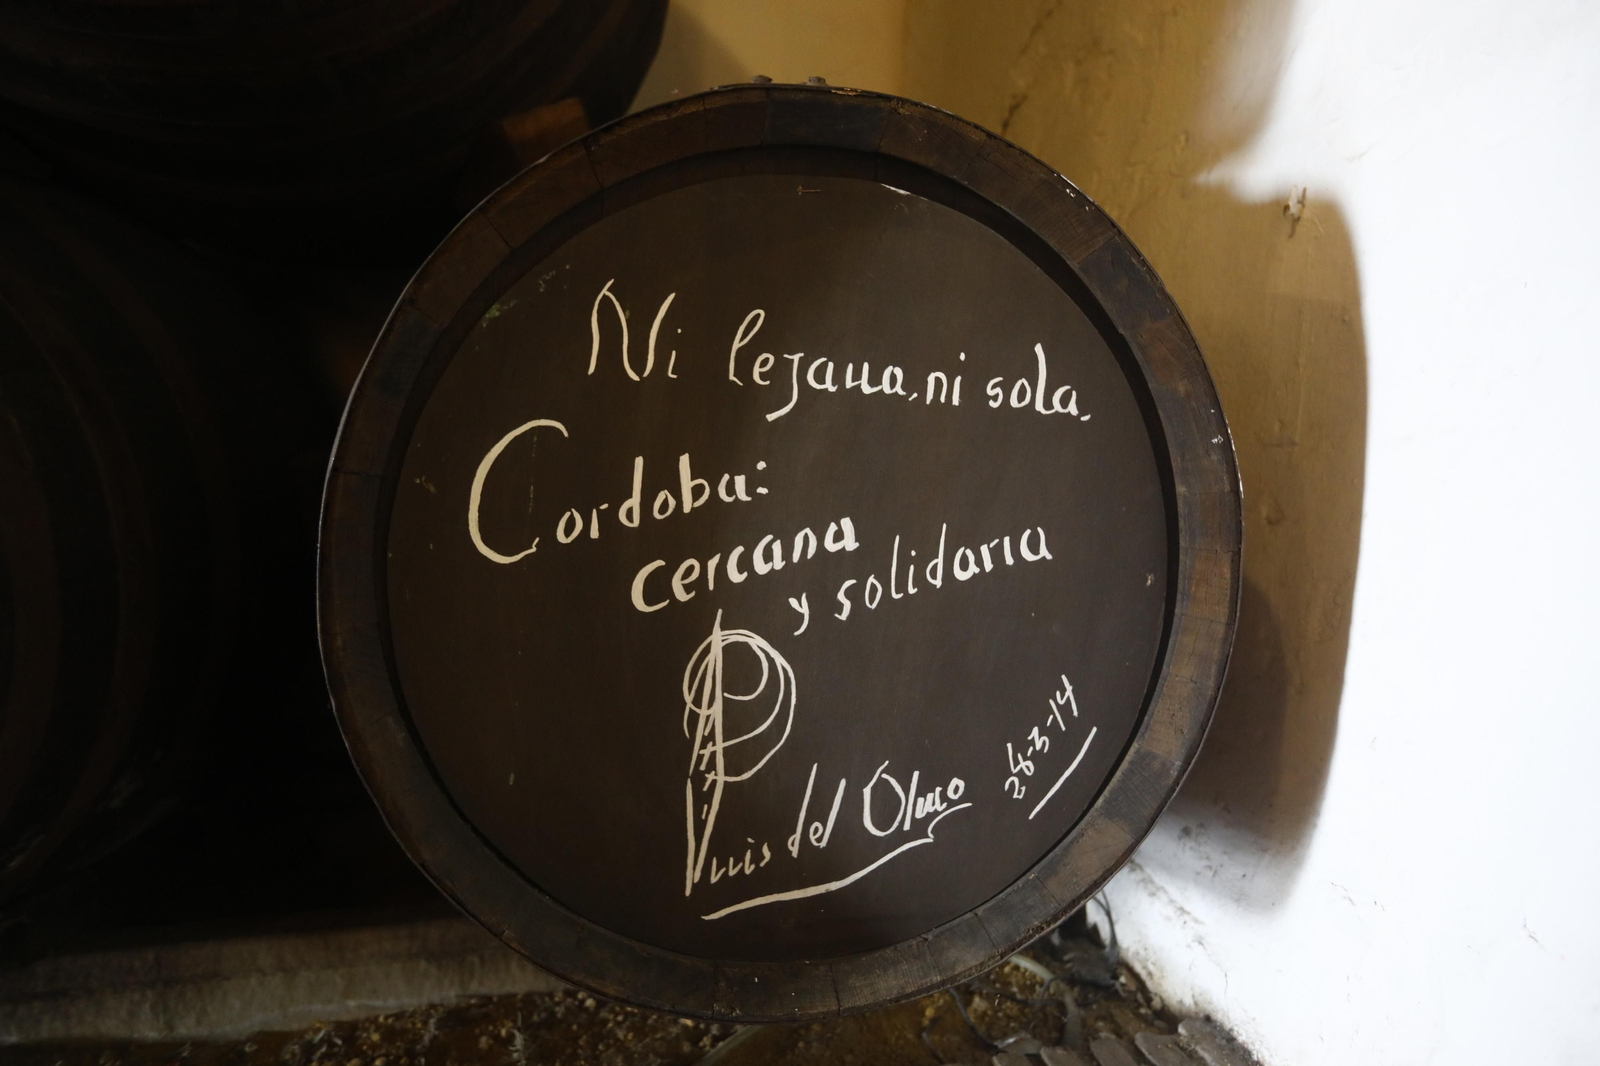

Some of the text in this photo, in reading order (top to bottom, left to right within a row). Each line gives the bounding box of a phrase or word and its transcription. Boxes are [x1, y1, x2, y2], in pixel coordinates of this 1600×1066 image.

[587, 278, 680, 382] Ni
[925, 351, 962, 407] ni
[468, 418, 769, 565] Cordoba:
[630, 516, 860, 614] cercana
[789, 522, 1054, 636] y solidaria
[1004, 673, 1079, 800] 28-3-14
[787, 762, 847, 859] del
[862, 759, 966, 838] Olmo
